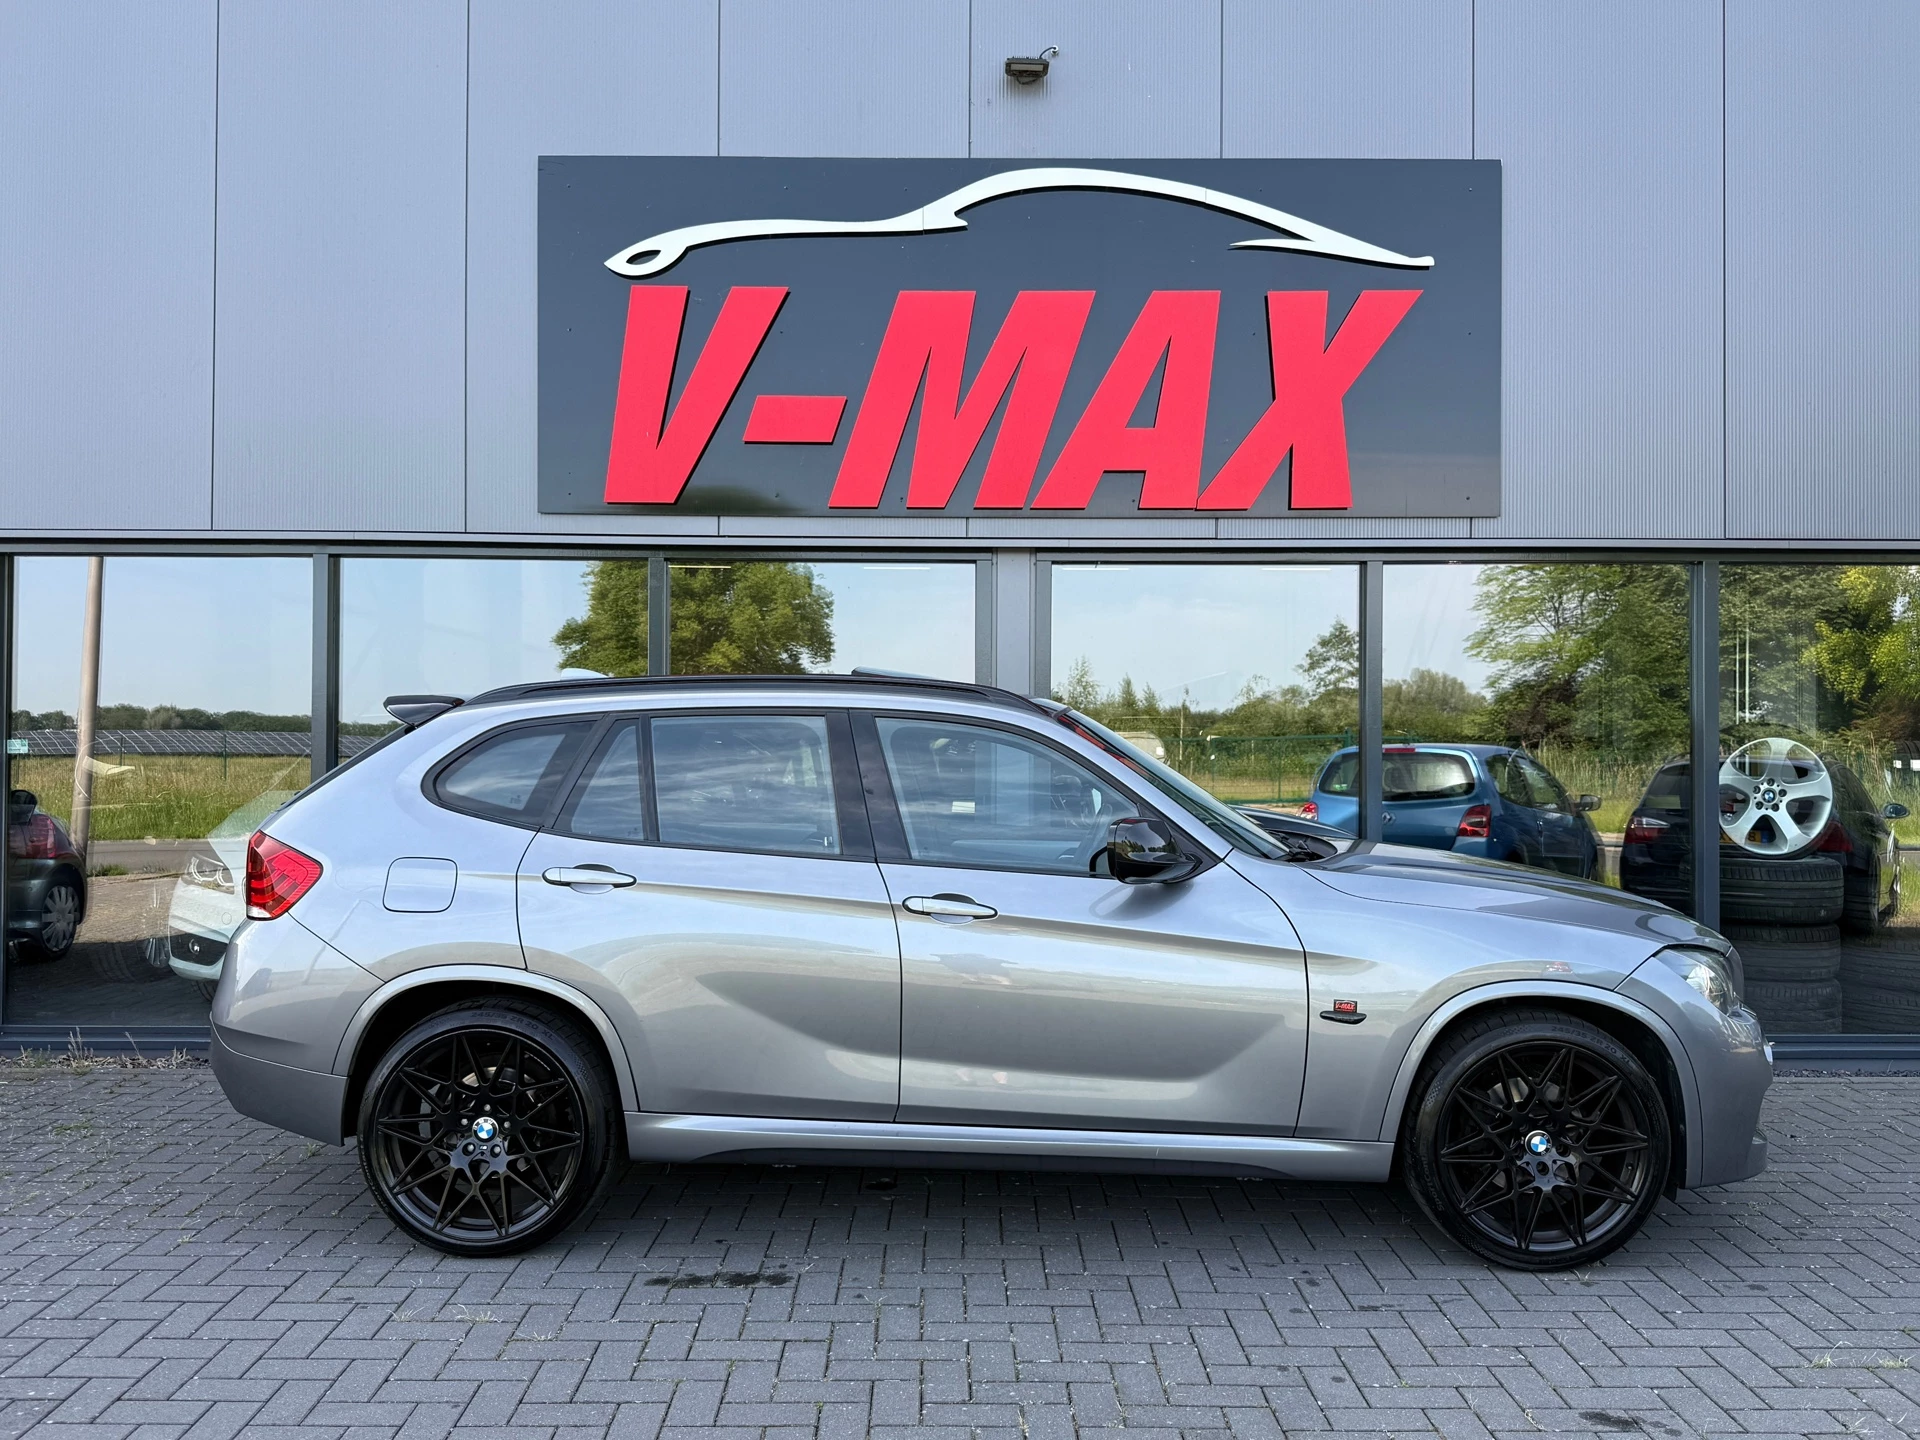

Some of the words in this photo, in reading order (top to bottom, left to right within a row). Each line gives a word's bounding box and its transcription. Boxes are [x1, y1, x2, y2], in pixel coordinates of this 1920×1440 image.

[604, 285, 1423, 509] V-MAX
[525, 1019, 539, 1029] 20
[541, 1028, 556, 1041] XL
[1604, 1043, 1617, 1054] 20
